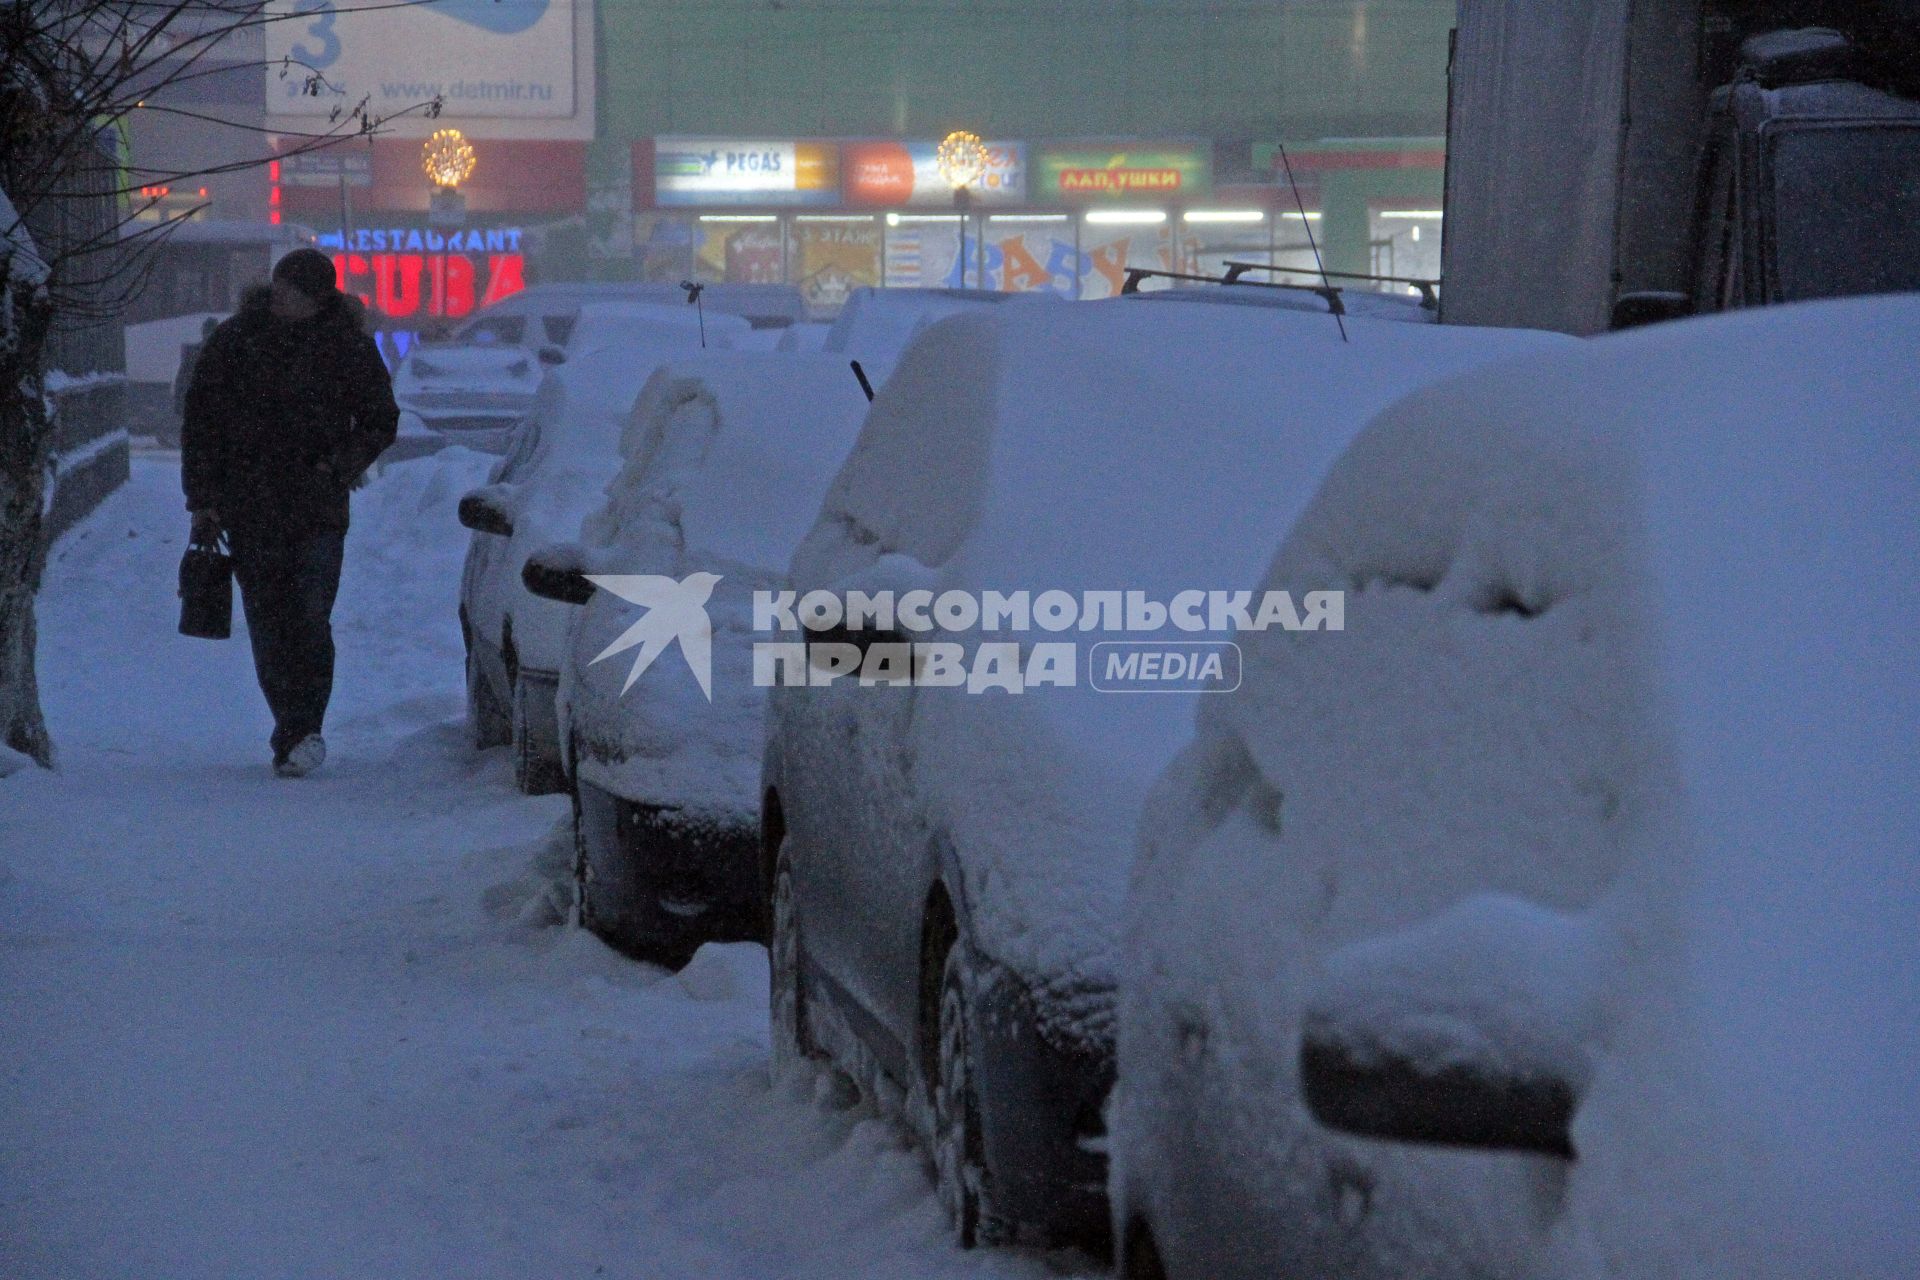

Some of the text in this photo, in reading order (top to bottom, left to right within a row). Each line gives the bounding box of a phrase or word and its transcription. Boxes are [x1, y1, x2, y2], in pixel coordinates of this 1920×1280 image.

[290, 0, 341, 68] 3
[381, 80, 553, 99] www.detmir.ru
[726, 152, 782, 172] PEGAS
[333, 253, 525, 318] CUBA
